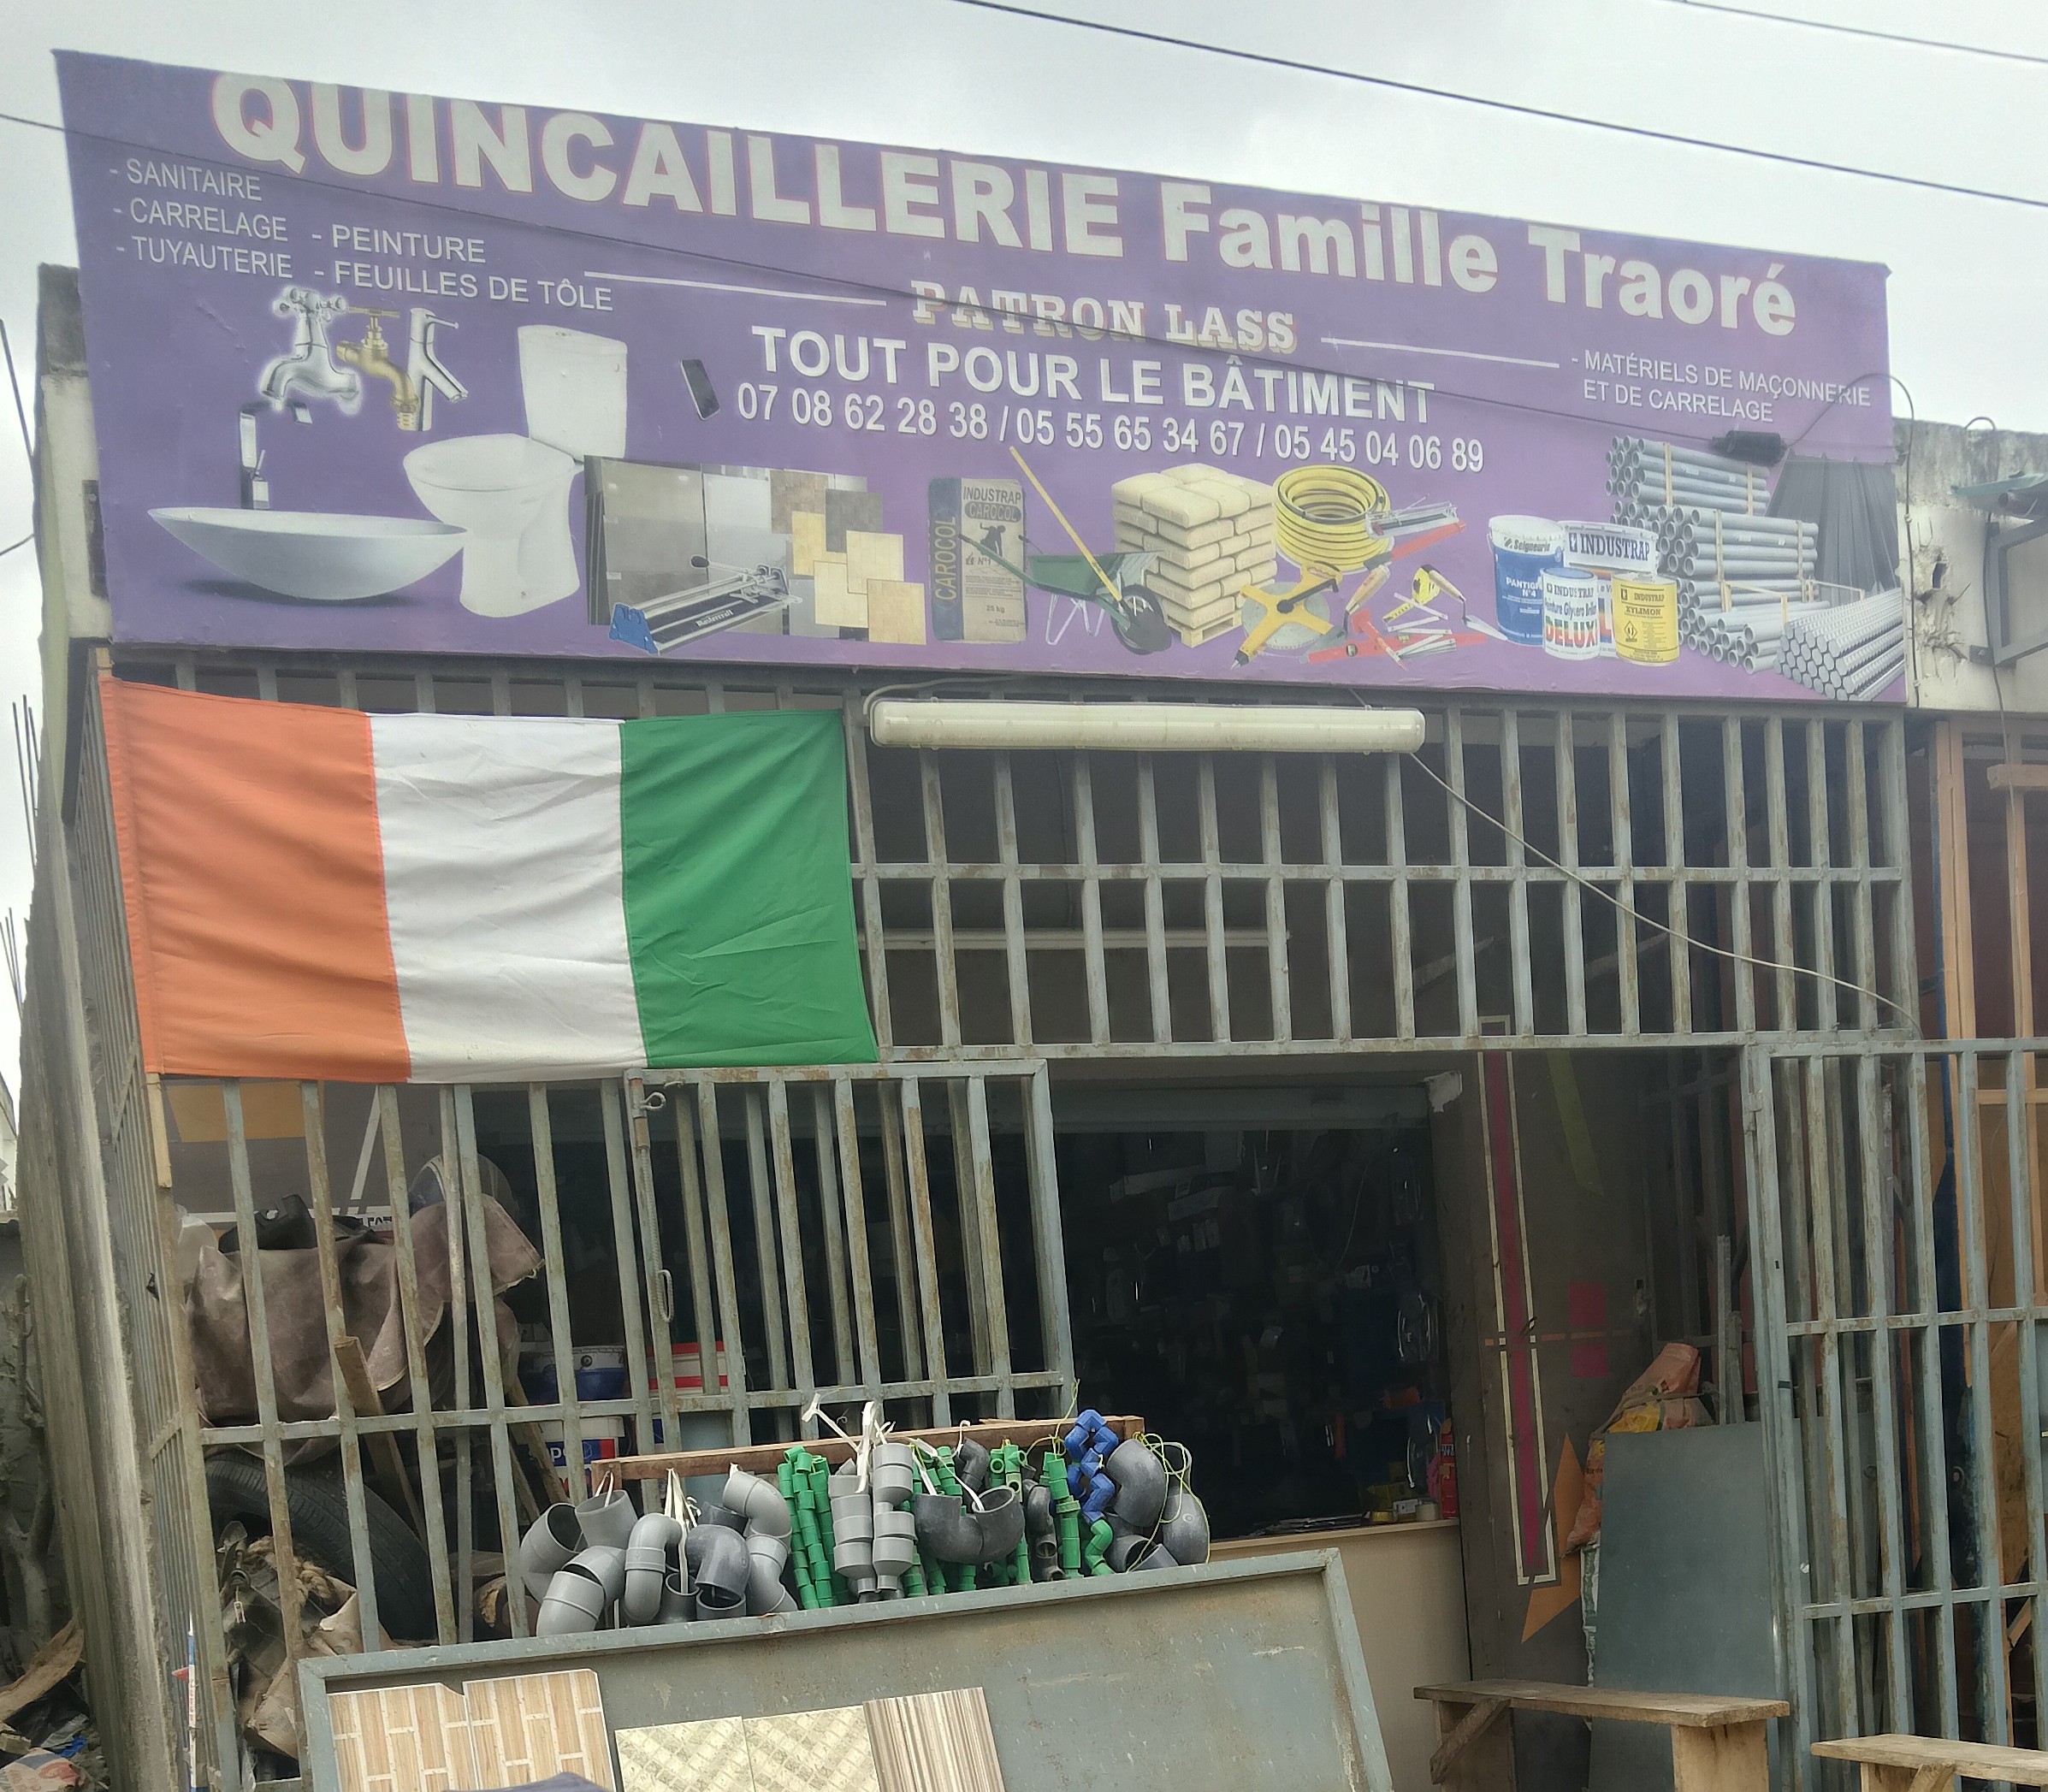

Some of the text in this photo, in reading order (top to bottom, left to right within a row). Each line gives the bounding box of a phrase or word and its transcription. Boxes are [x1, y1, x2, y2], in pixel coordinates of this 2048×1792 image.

[127, 158, 263, 200] SANITAIRE
[129, 198, 288, 242] CARRELAGE
[212, 74, 1796, 335] QUINCAILLERIE Famille Traoré
[132, 235, 293, 279] TUYAUTERIE
[332, 225, 486, 263] PEINTURE
[334, 261, 478, 299] FEUILLES
[489, 276, 529, 303] DE
[537, 278, 613, 310] TÔLE
[911, 281, 1297, 354] PATRON LASS
[752, 326, 1435, 424] TOUT POUR LE BÂTIMENT
[1584, 350, 1698, 384] MATÉRIELS
[1705, 367, 1733, 388] DE
[1740, 371, 1871, 407] MAÇONNERIE
[1584, 379, 1773, 423] ET DE CARRELAGE
[738, 382, 778, 421] 07
[792, 388, 832, 427] 08
[845, 393, 885, 431] 62
[897, 398, 937, 435] 28
[950, 402, 988, 440] 38
[1017, 408, 1055, 446] 05
[1067, 412, 1104, 449] 55
[1115, 416, 1151, 451] 65
[1163, 417, 1199, 453] 34
[1210, 420, 1245, 456] 67
[1275, 424, 1311, 459] 05
[1321, 428, 1356, 463] 45
[1366, 431, 1400, 466] 04
[1409, 435, 1441, 470] 06
[1452, 438, 1483, 472] 89
[963, 486, 1021, 505] INDUSTRAP
[969, 502, 1017, 522] CAROCOL
[935, 516, 956, 600] CAROCOL
[1580, 533, 1649, 561] INDUSTRAP
